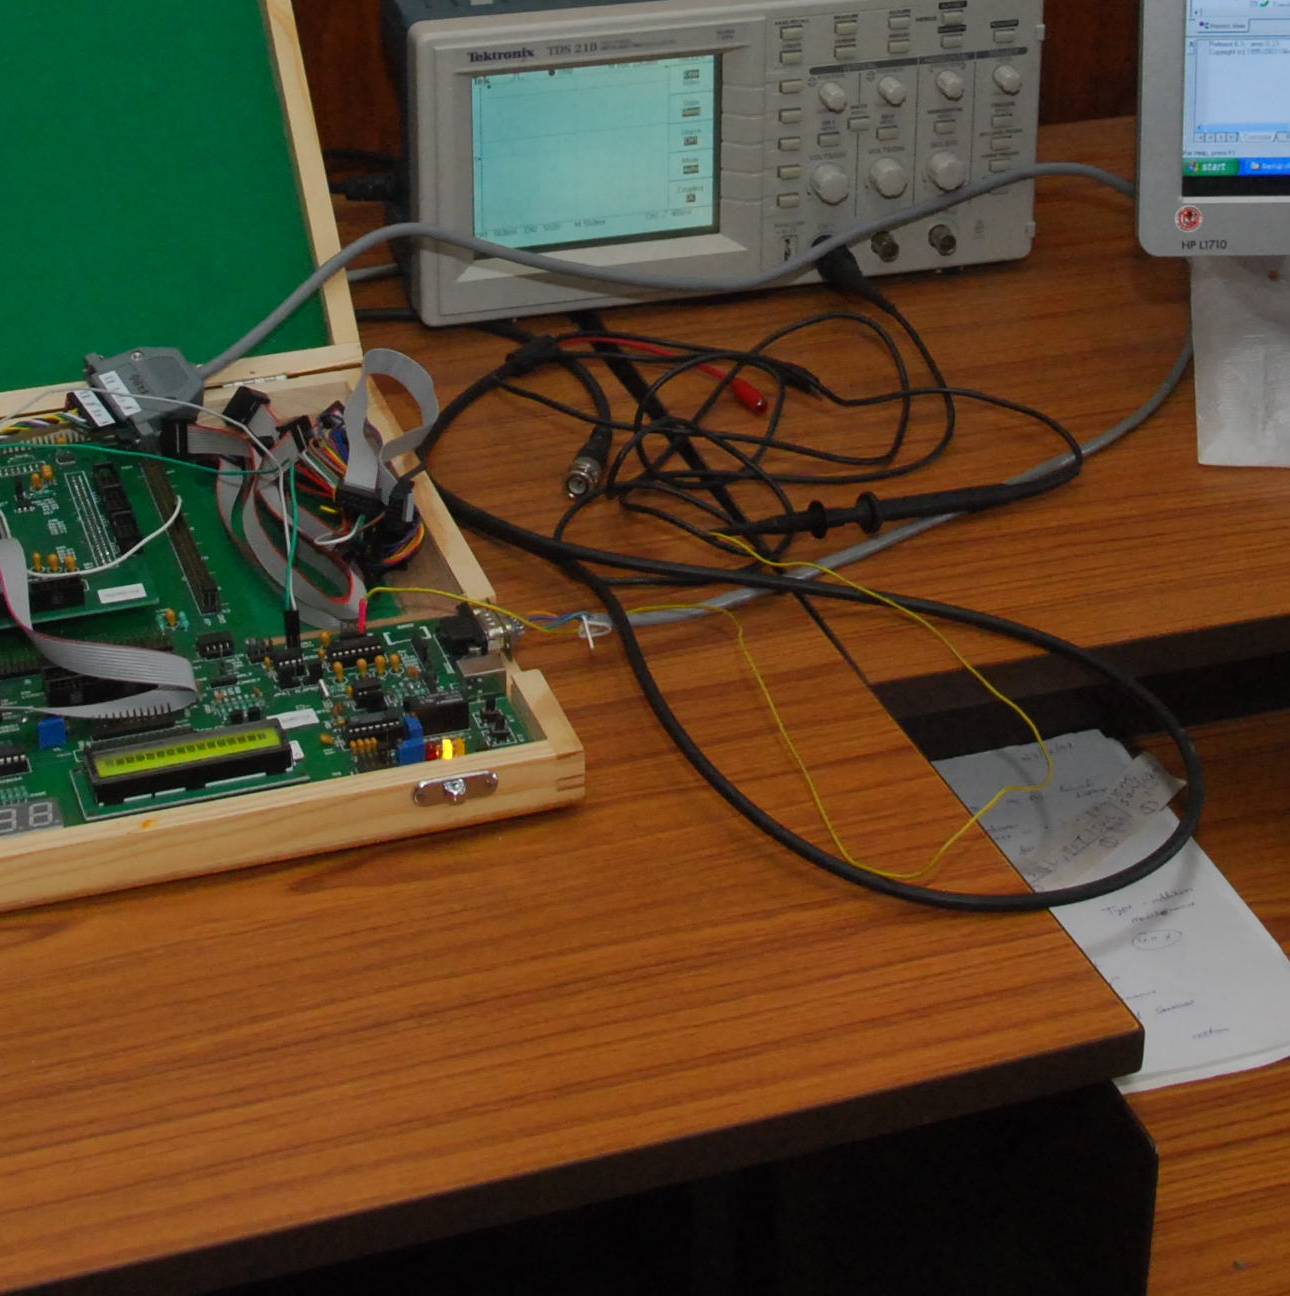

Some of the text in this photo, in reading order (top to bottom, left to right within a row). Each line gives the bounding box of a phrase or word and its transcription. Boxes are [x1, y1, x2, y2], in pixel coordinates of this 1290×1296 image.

[468, 47, 535, 62] Tektronix
[547, 46, 571, 56] TDS
[1202, 161, 1227, 171] start
[1181, 240, 1227, 249] HP L1710
